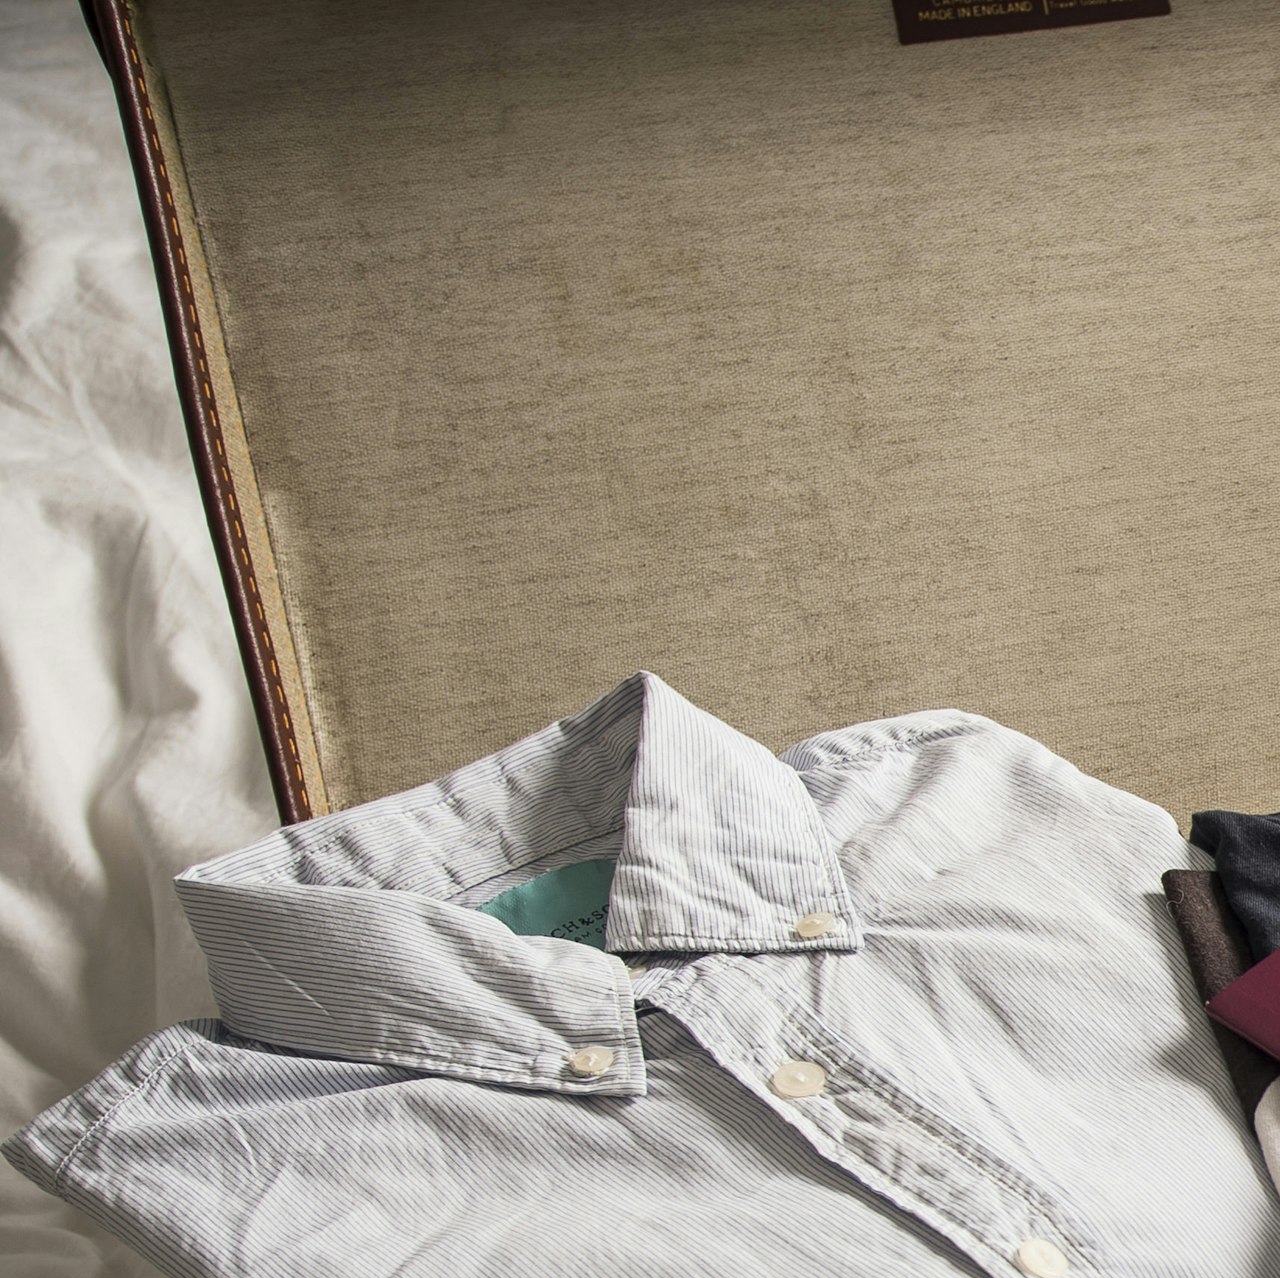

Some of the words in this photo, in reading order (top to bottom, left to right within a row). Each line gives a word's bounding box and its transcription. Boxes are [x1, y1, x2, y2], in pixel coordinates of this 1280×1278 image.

[918, 8, 955, 21] MADE
[957, 7, 971, 18] IN
[972, 1, 1033, 17] ENGLAND
